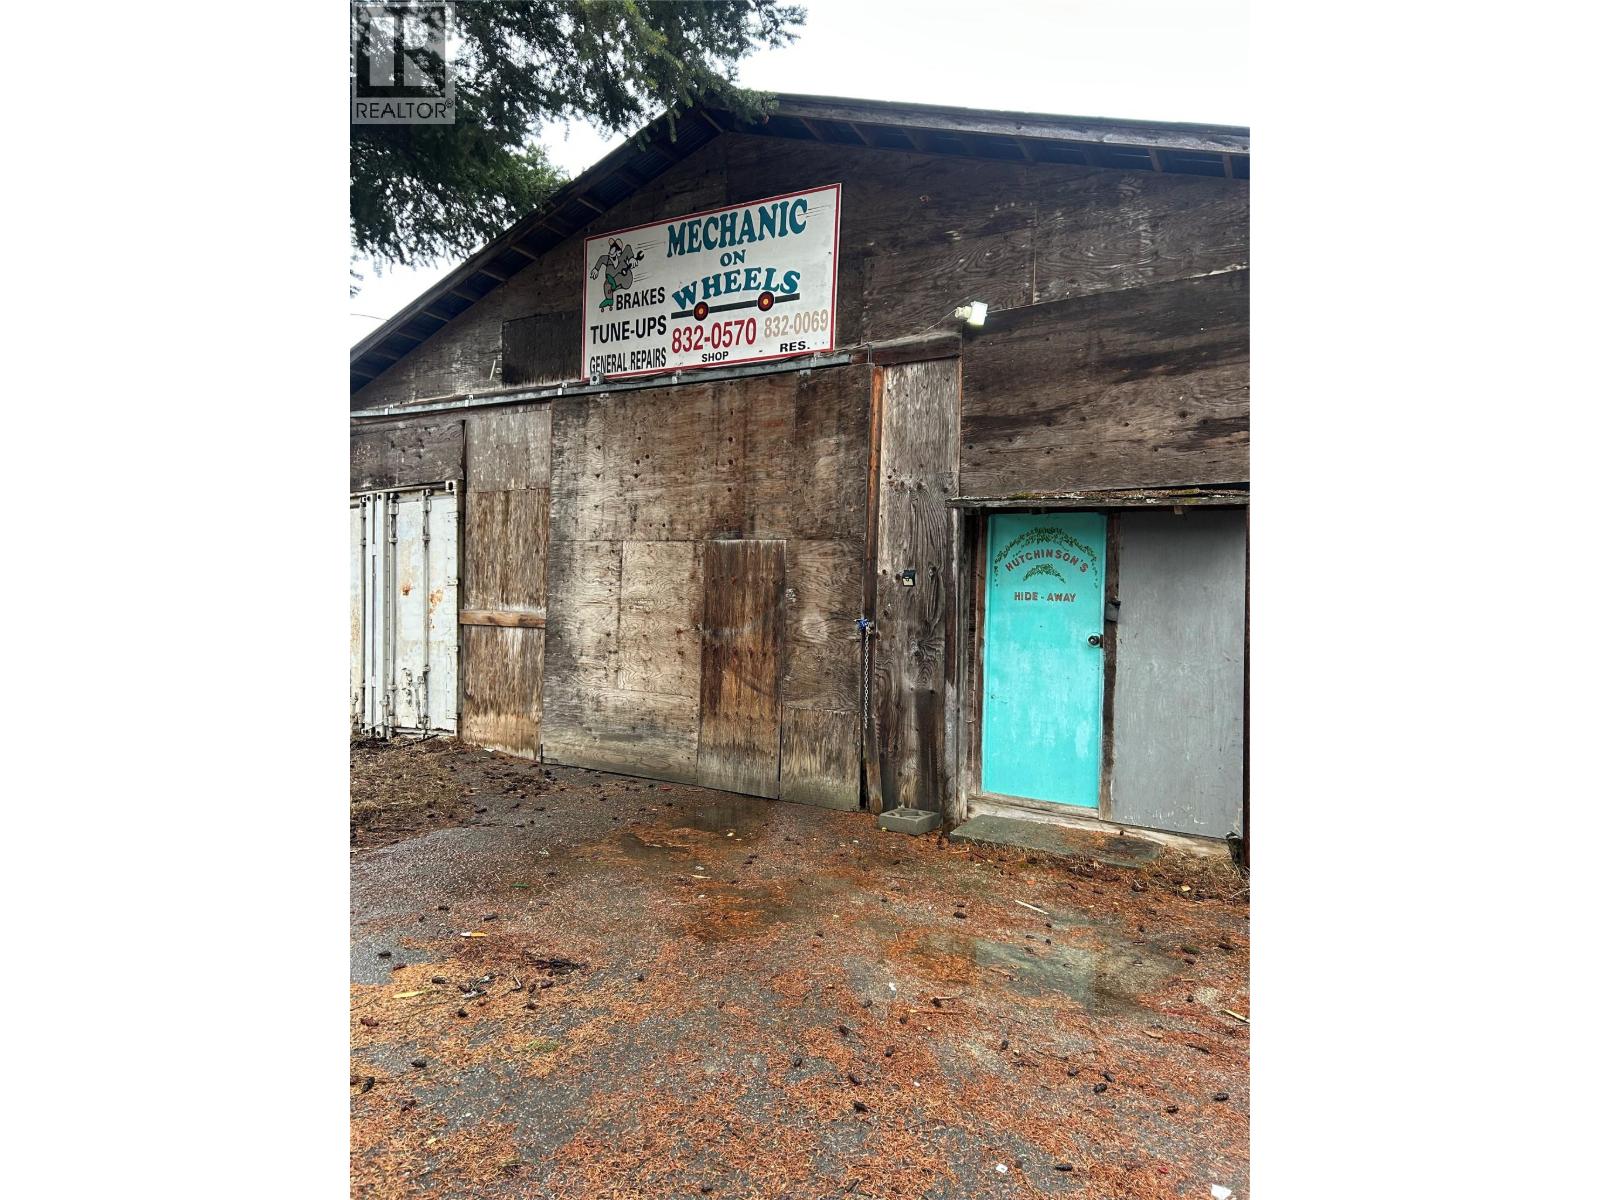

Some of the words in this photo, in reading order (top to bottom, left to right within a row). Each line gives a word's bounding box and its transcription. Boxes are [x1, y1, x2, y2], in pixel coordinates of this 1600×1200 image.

[667, 199, 808, 257] MECHANIC
[720, 250, 746, 266] ON
[616, 287, 666, 310] BRAKES
[672, 267, 800, 310] WHEELS
[590, 315, 667, 344] TUNE-UPS
[672, 317, 757, 354] 832-0570
[764, 309, 829, 338] 832-0069
[702, 351, 729, 362] SHOP
[780, 341, 810, 352] RES.
[590, 353, 628, 374] GENERAL
[630, 347, 666, 370] REPAIRS
[1005, 548, 1089, 573] HUTCHINSON'S
[1014, 592, 1038, 601] HIDE
[1047, 592, 1076, 602] AWAY
